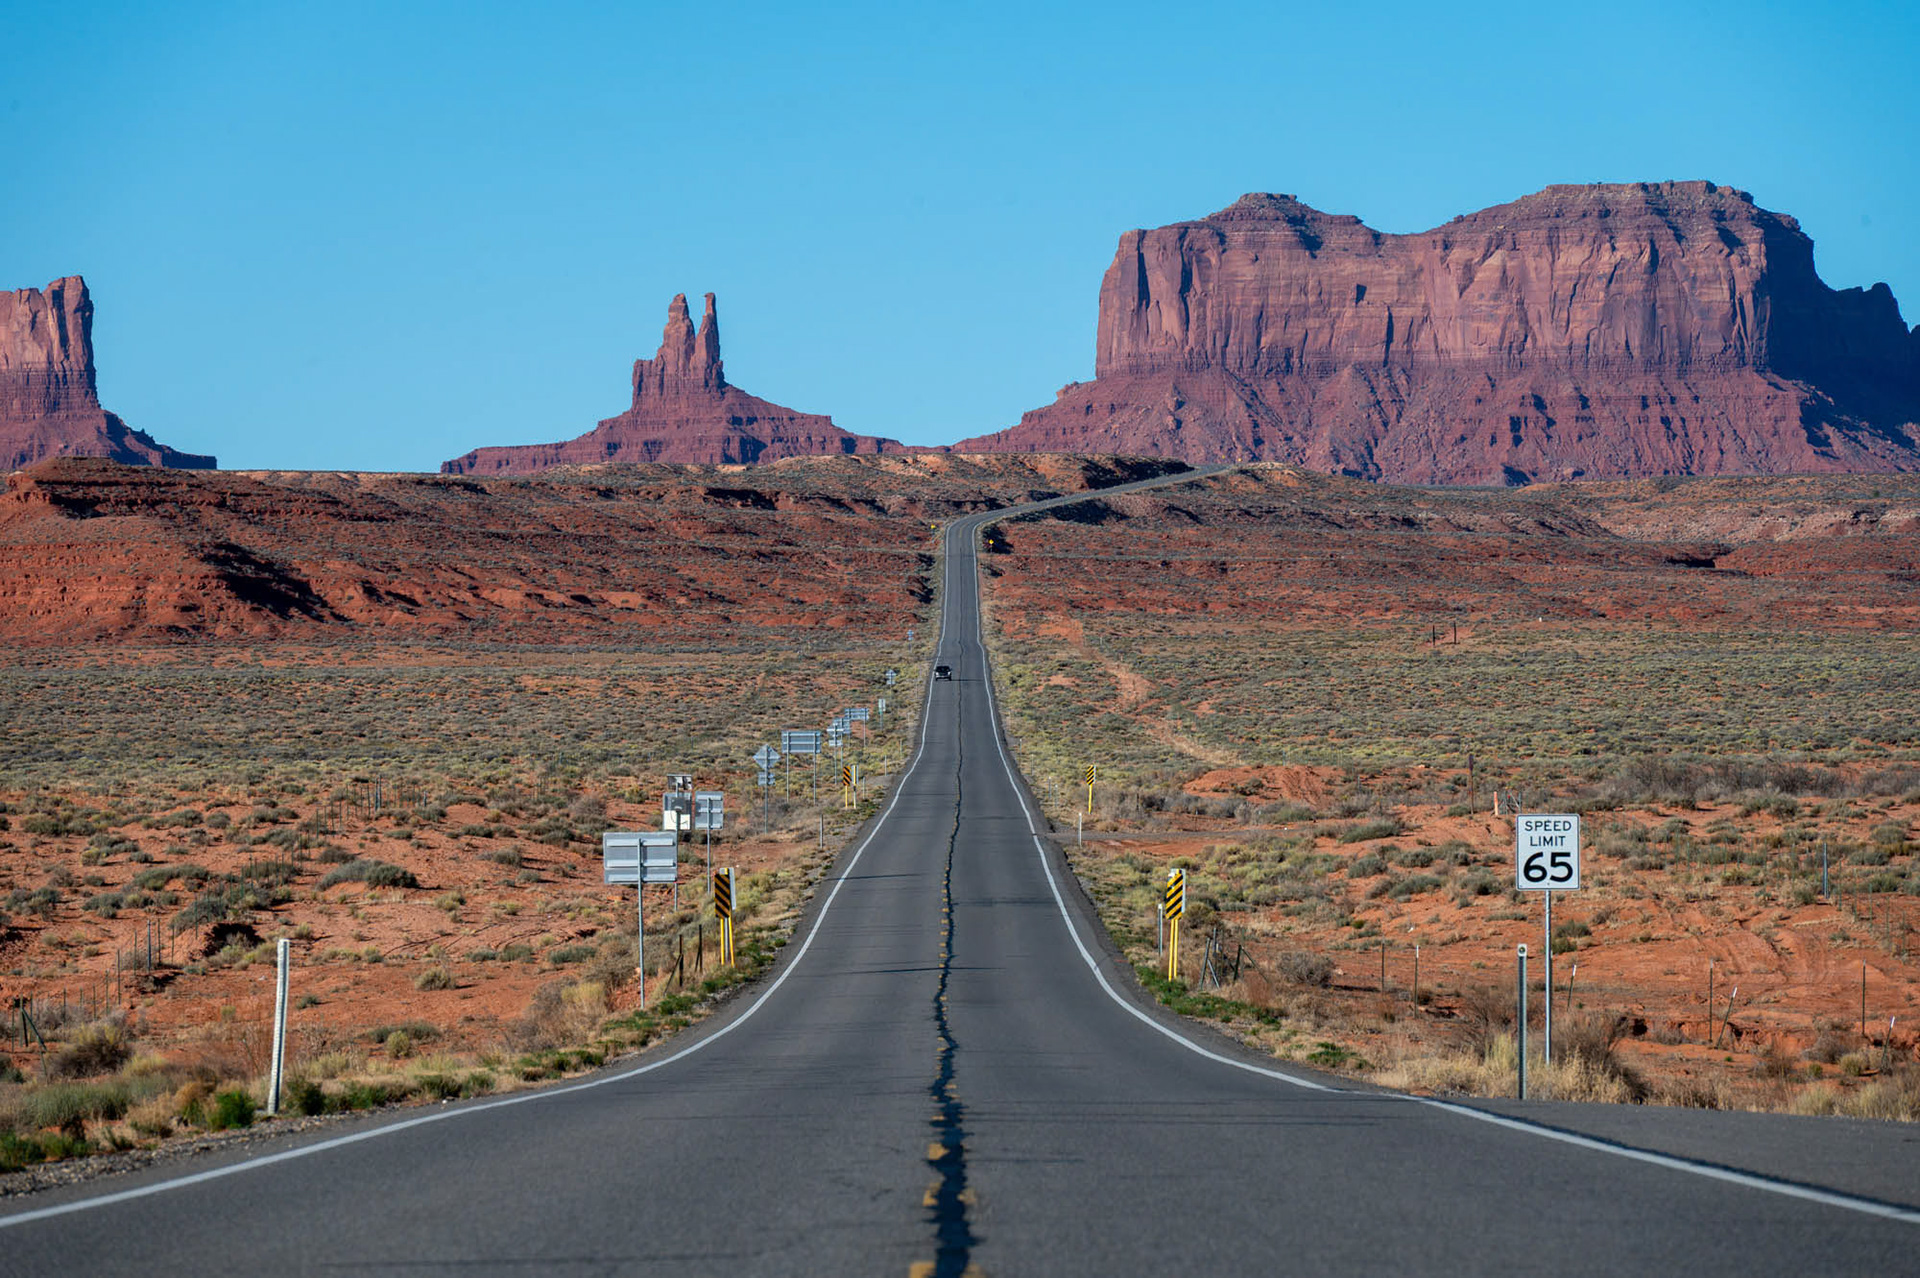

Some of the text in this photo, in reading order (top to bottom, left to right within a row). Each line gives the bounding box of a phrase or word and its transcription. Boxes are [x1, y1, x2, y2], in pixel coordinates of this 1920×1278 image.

[1524, 820, 1572, 832] SPEED
[1530, 835, 1566, 847] LIMIT
[1523, 851, 1574, 883] 65
